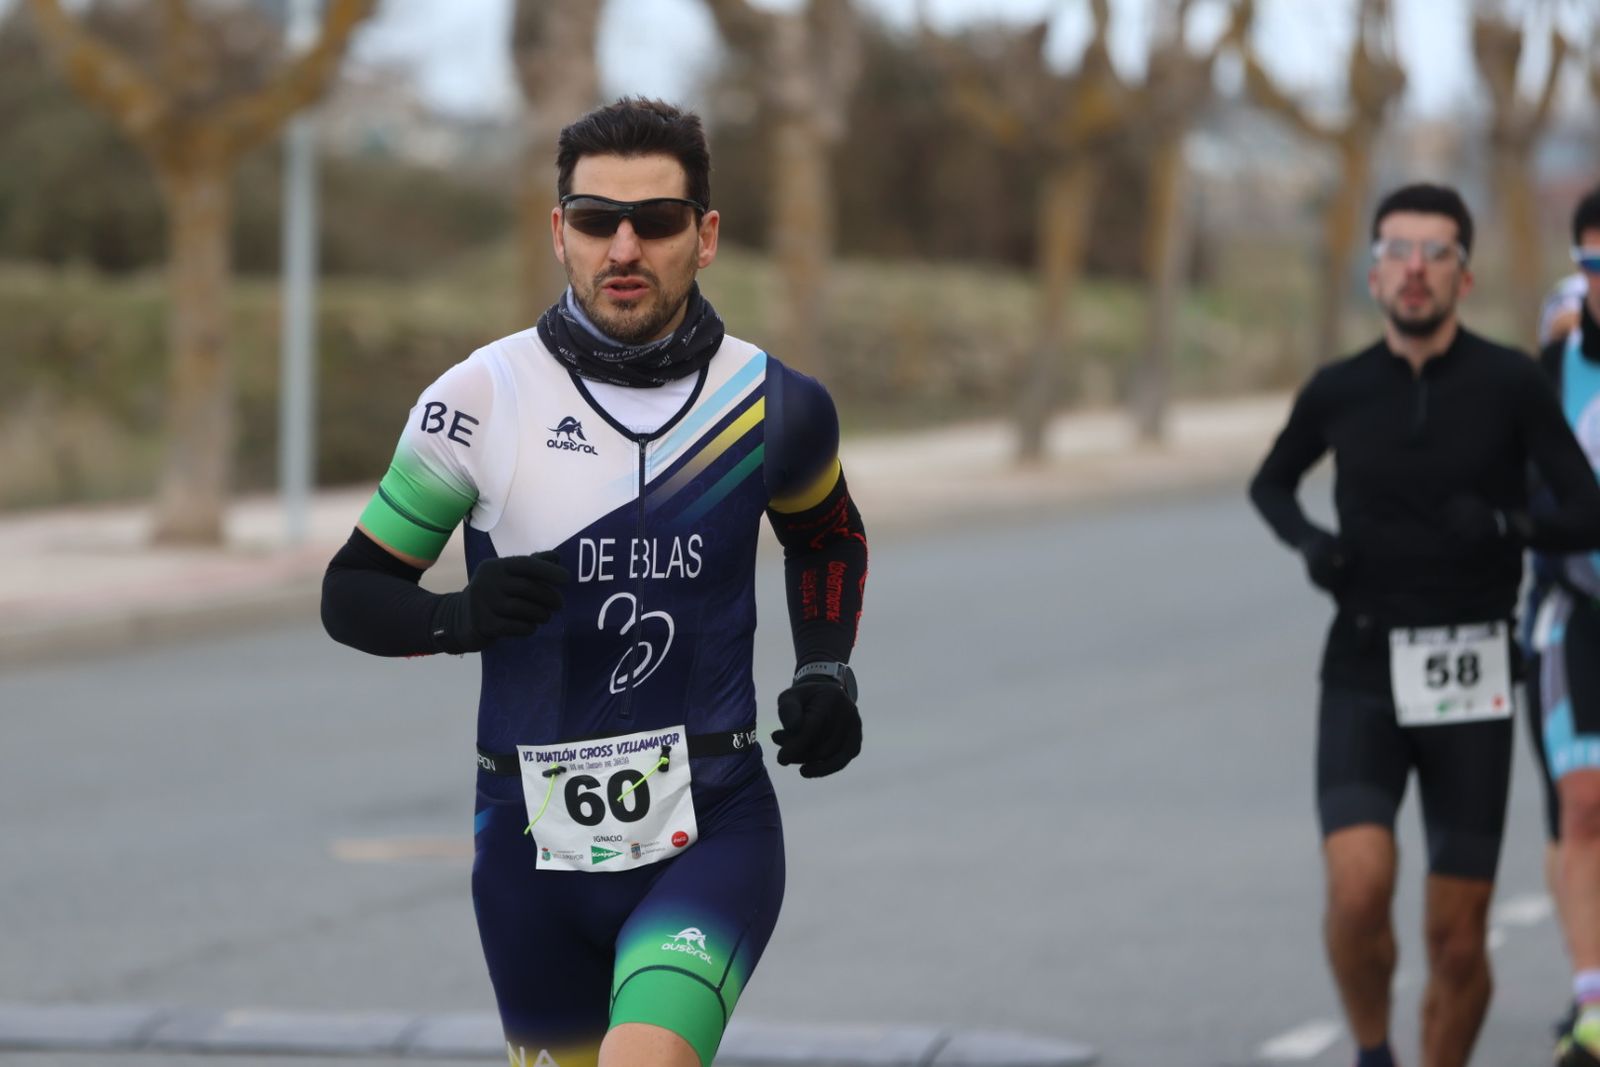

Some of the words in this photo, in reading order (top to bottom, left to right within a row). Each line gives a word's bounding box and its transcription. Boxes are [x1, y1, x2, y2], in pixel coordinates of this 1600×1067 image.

[421, 401, 479, 447] BE
[546, 439, 599, 456] austral
[578, 538, 616, 582] DE
[629, 534, 703, 579] BLAS
[1425, 652, 1479, 689] 58
[523, 751, 533, 761] VI
[535, 748, 576, 763] DUATLÓN
[580, 744, 613, 760] CROSS
[616, 732, 680, 754] VILLAMAYOR
[564, 769, 651, 827] 60
[661, 943, 712, 965] austral
